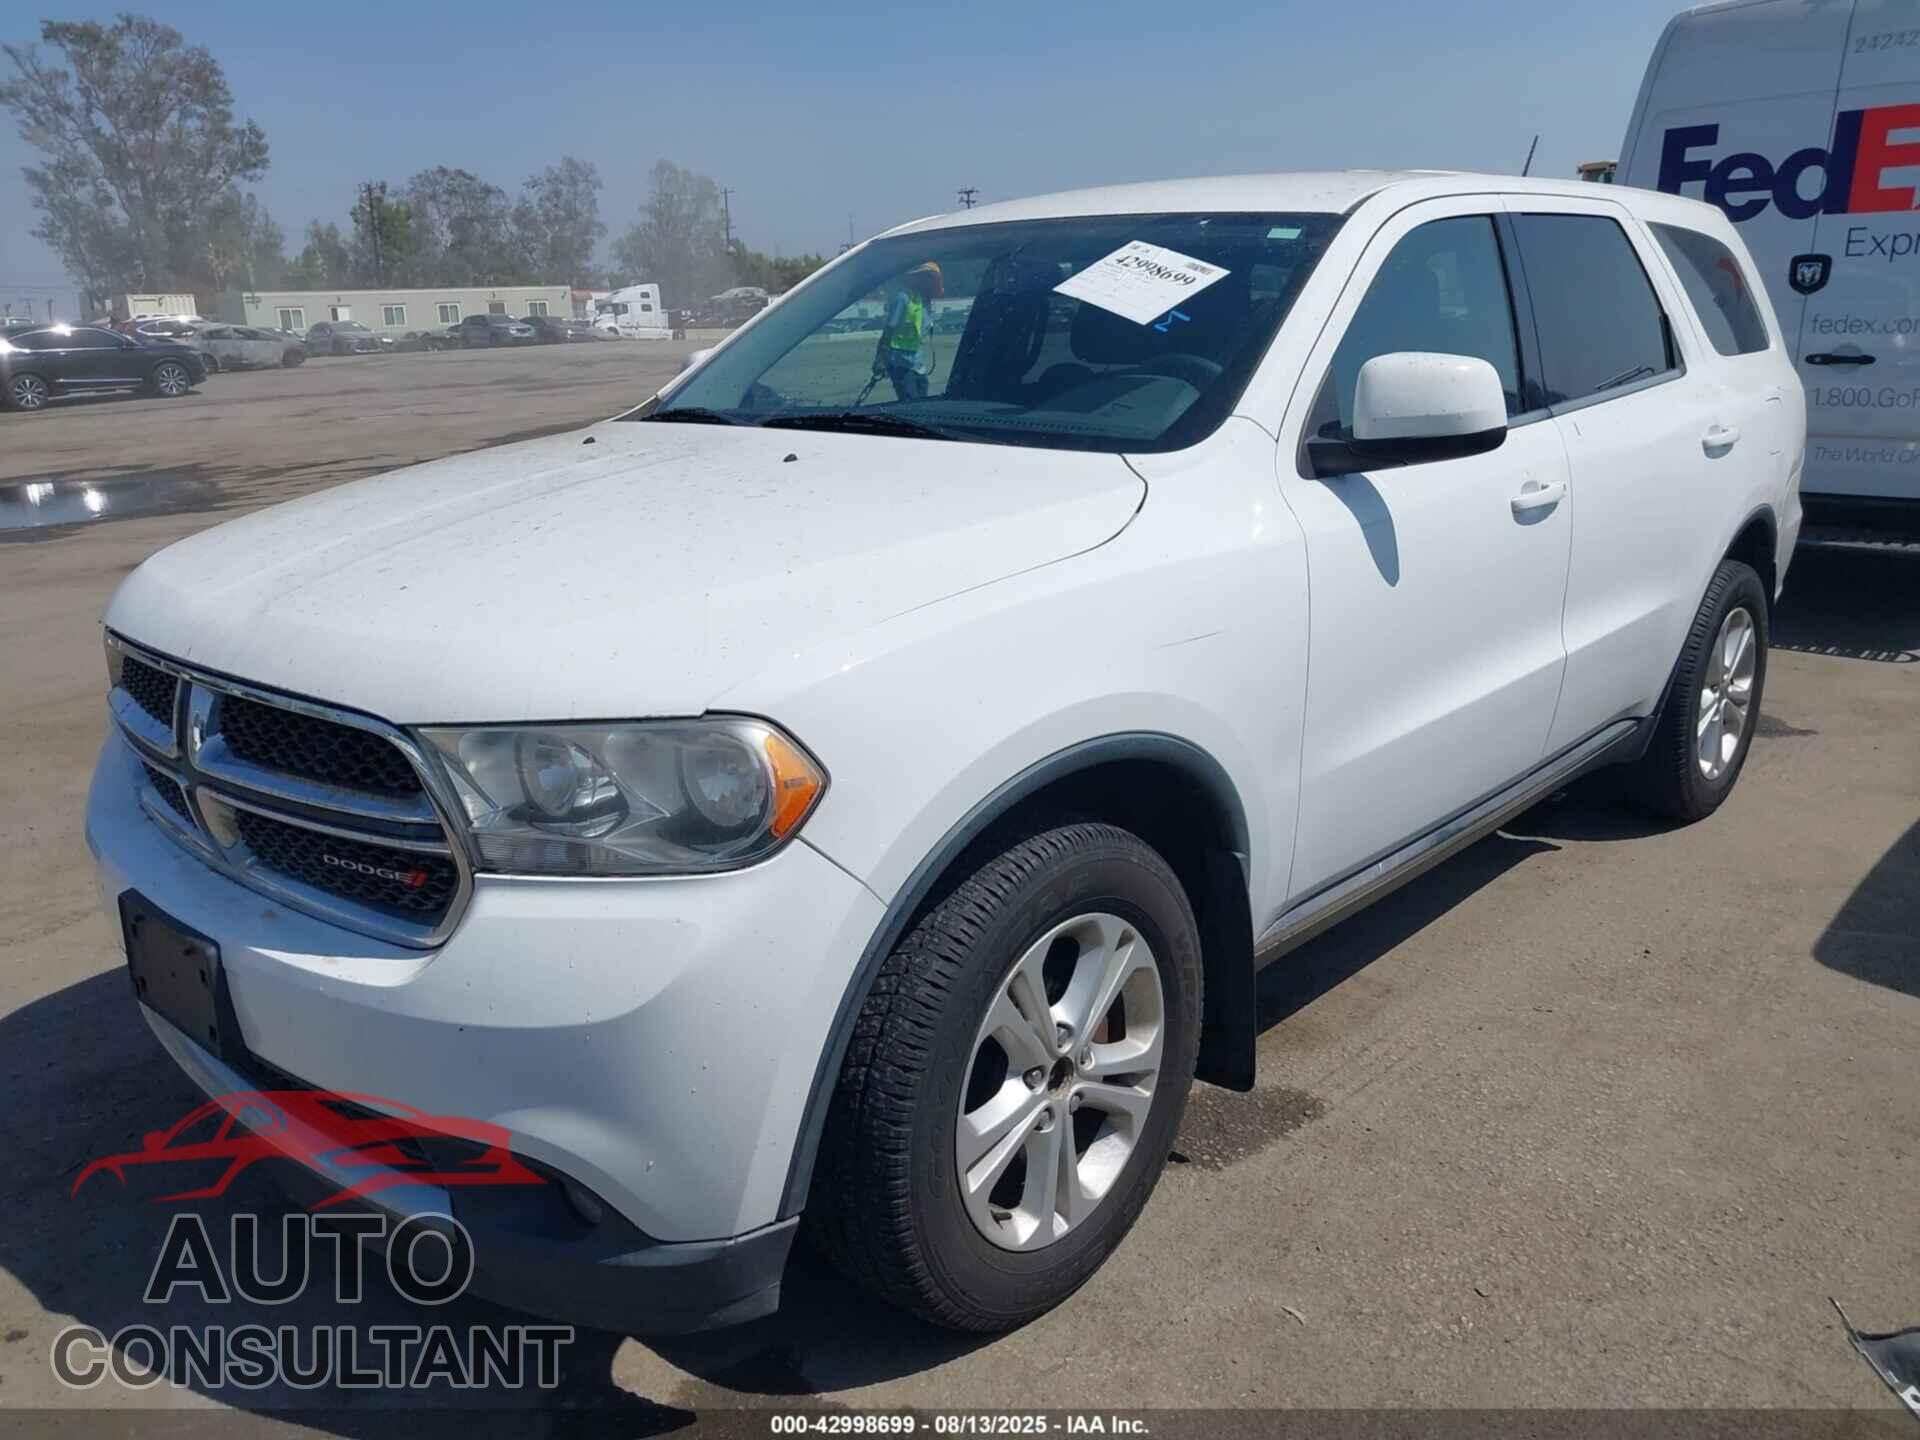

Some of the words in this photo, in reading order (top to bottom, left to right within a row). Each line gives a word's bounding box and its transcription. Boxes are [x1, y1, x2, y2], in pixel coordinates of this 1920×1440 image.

[1657, 104, 1920, 222] FedE
[1115, 255, 1197, 286] 42998699
[323, 854, 413, 884] DODGE
